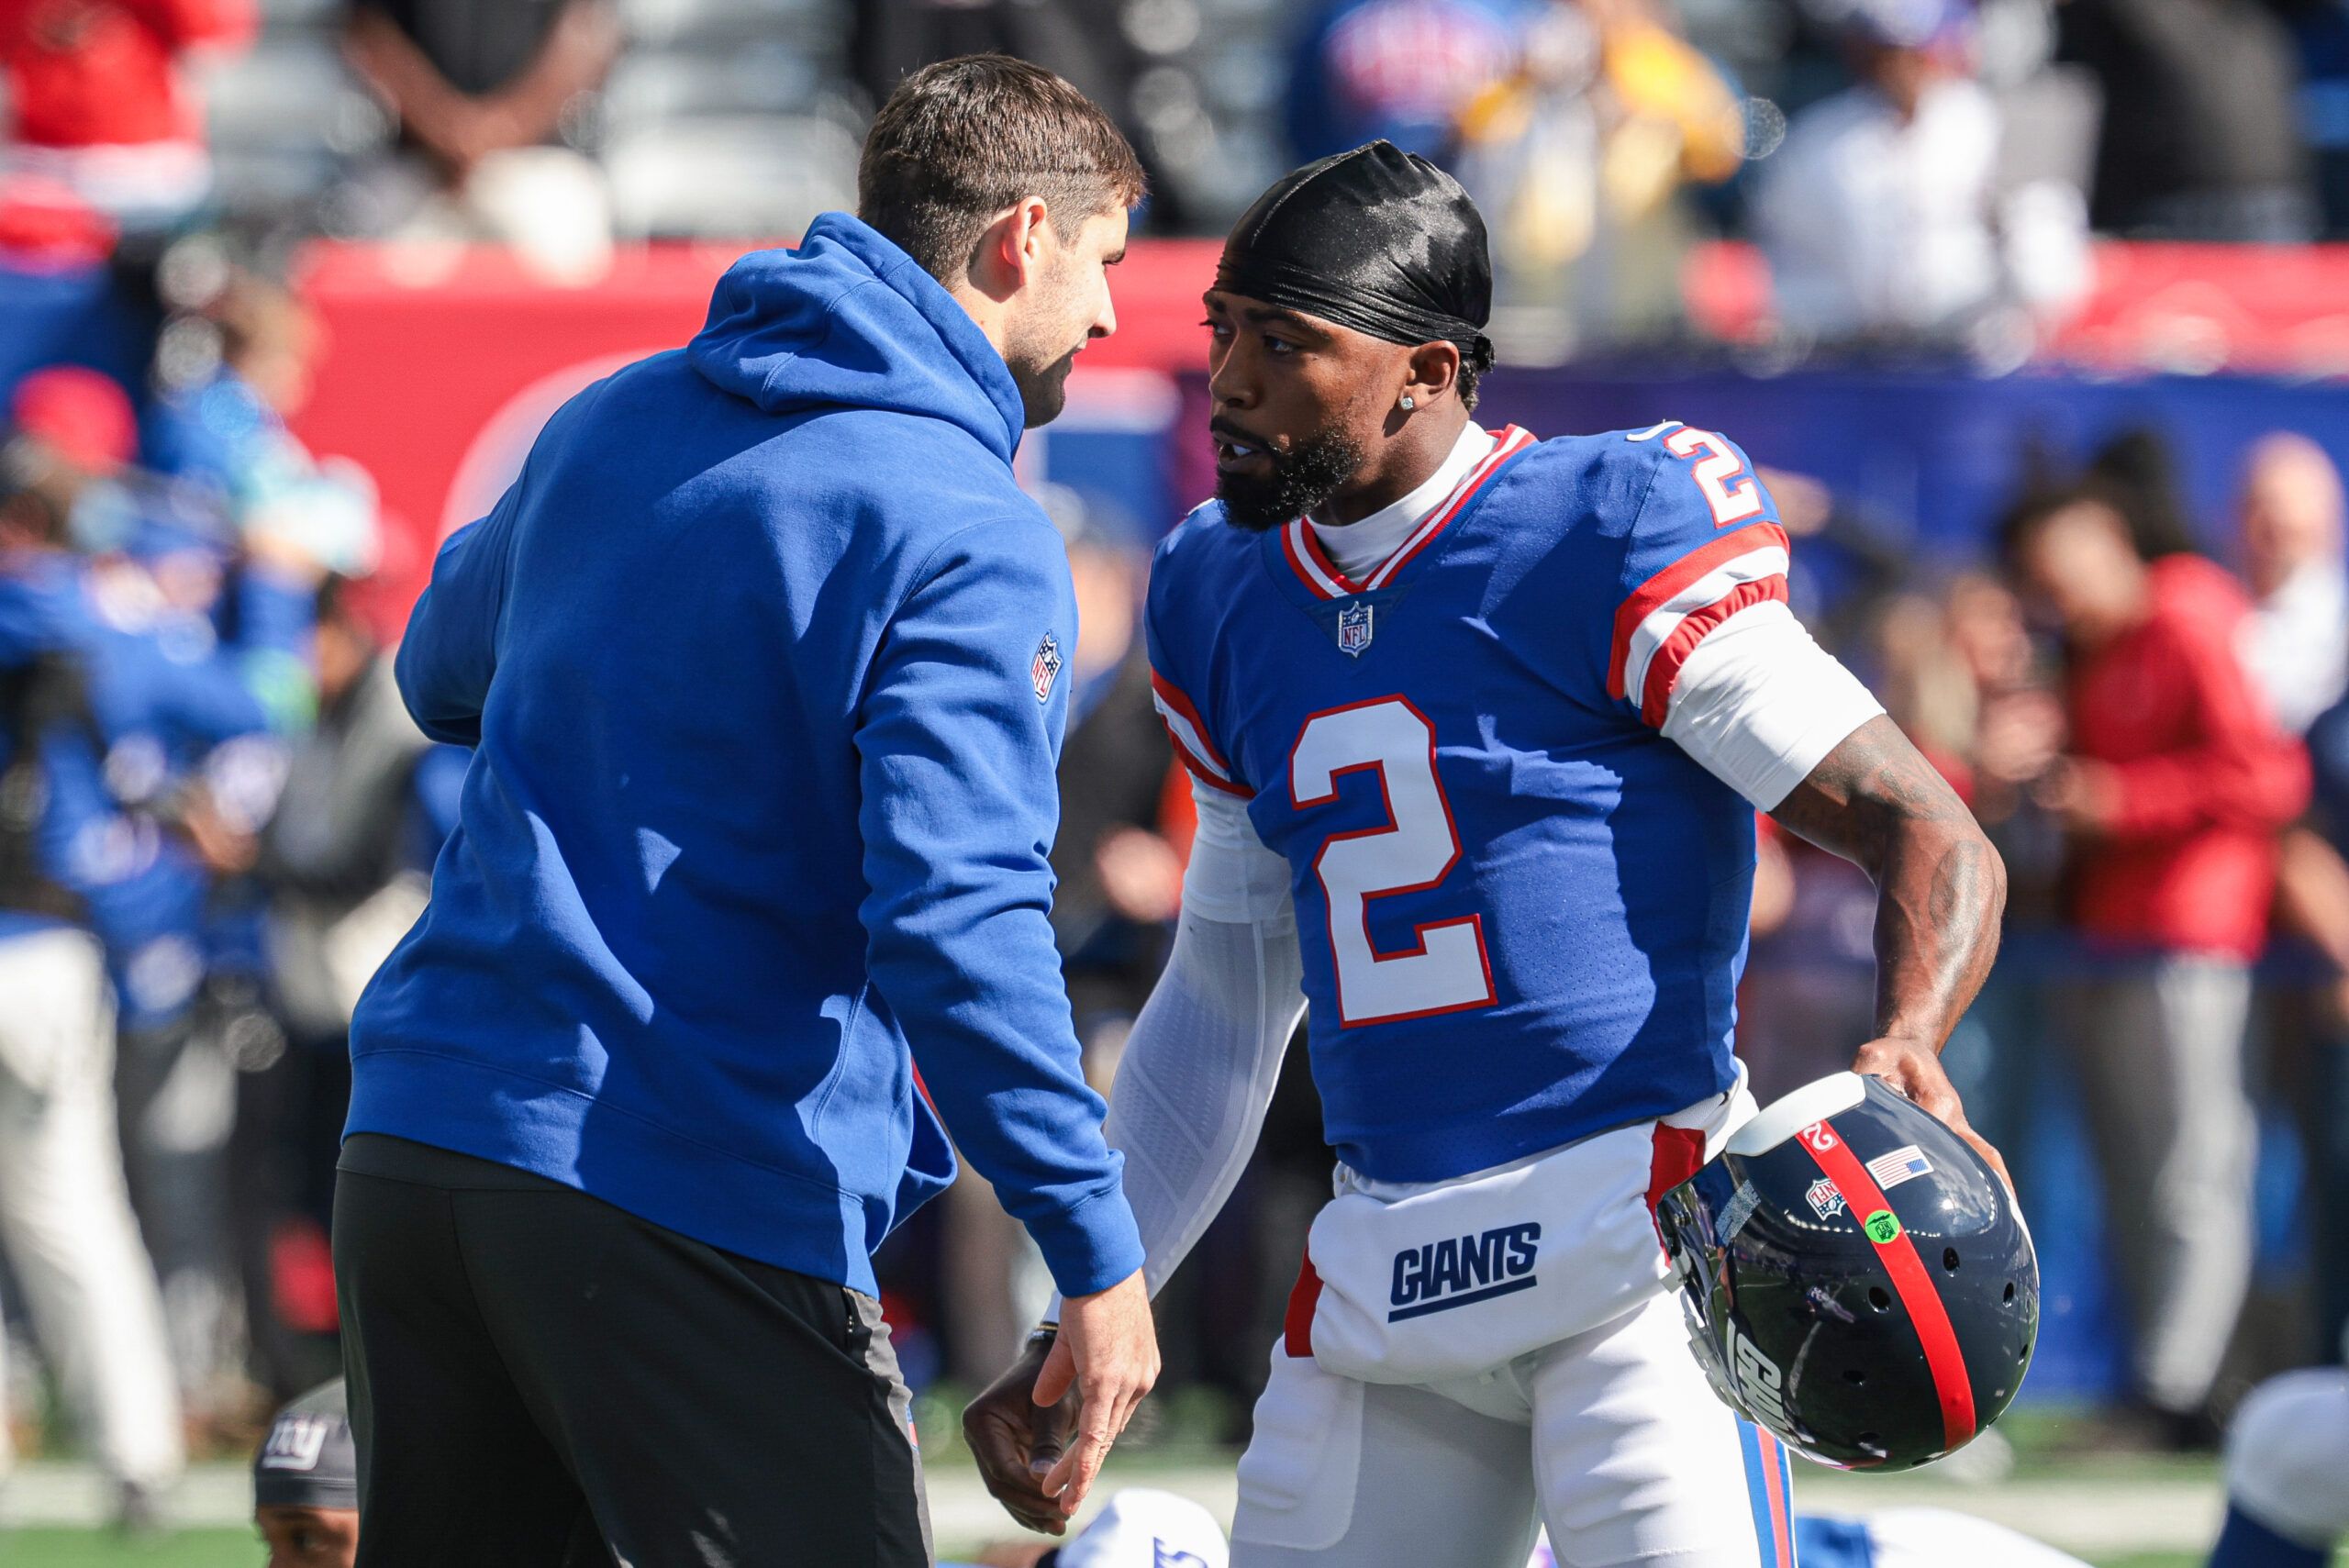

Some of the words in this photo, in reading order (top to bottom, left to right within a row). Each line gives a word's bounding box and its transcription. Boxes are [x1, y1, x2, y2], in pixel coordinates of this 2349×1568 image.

[1663, 427, 1764, 529] 2
[1343, 626, 1366, 646] NFL
[1032, 655, 1050, 693] NFL
[1288, 693, 1497, 1029] 2
[1803, 1121, 1833, 1151] 2
[1810, 1184, 1837, 1205] NFL
[1390, 1221, 1542, 1307] GIANTS
